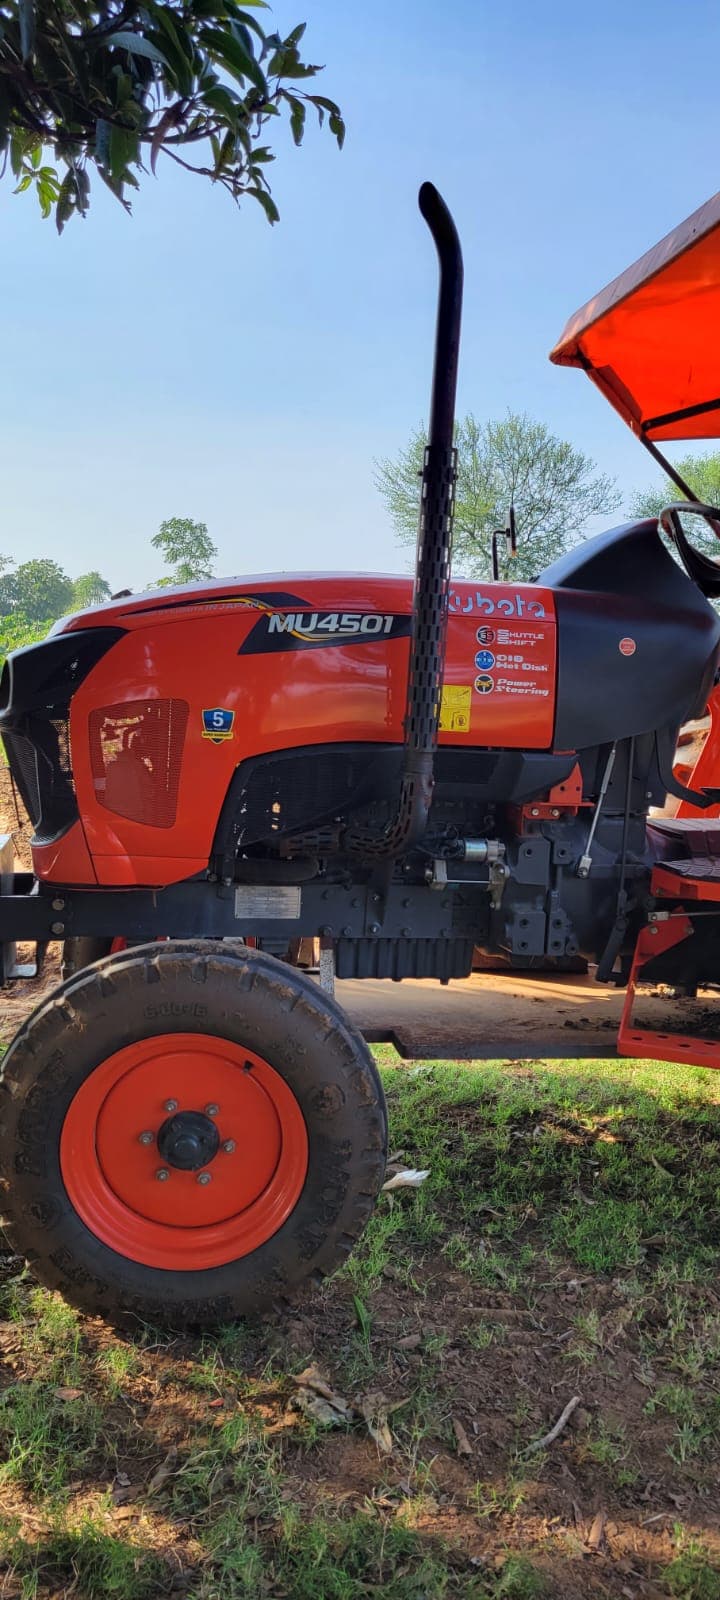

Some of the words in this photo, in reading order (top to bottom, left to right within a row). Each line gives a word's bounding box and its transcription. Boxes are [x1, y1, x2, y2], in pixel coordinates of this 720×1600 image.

[445, 589, 545, 618] Kubota
[268, 613, 394, 633] MU4501
[495, 685, 549, 697] Steering
[497, 678, 536, 688] Power
[212, 711, 224, 727] 5
